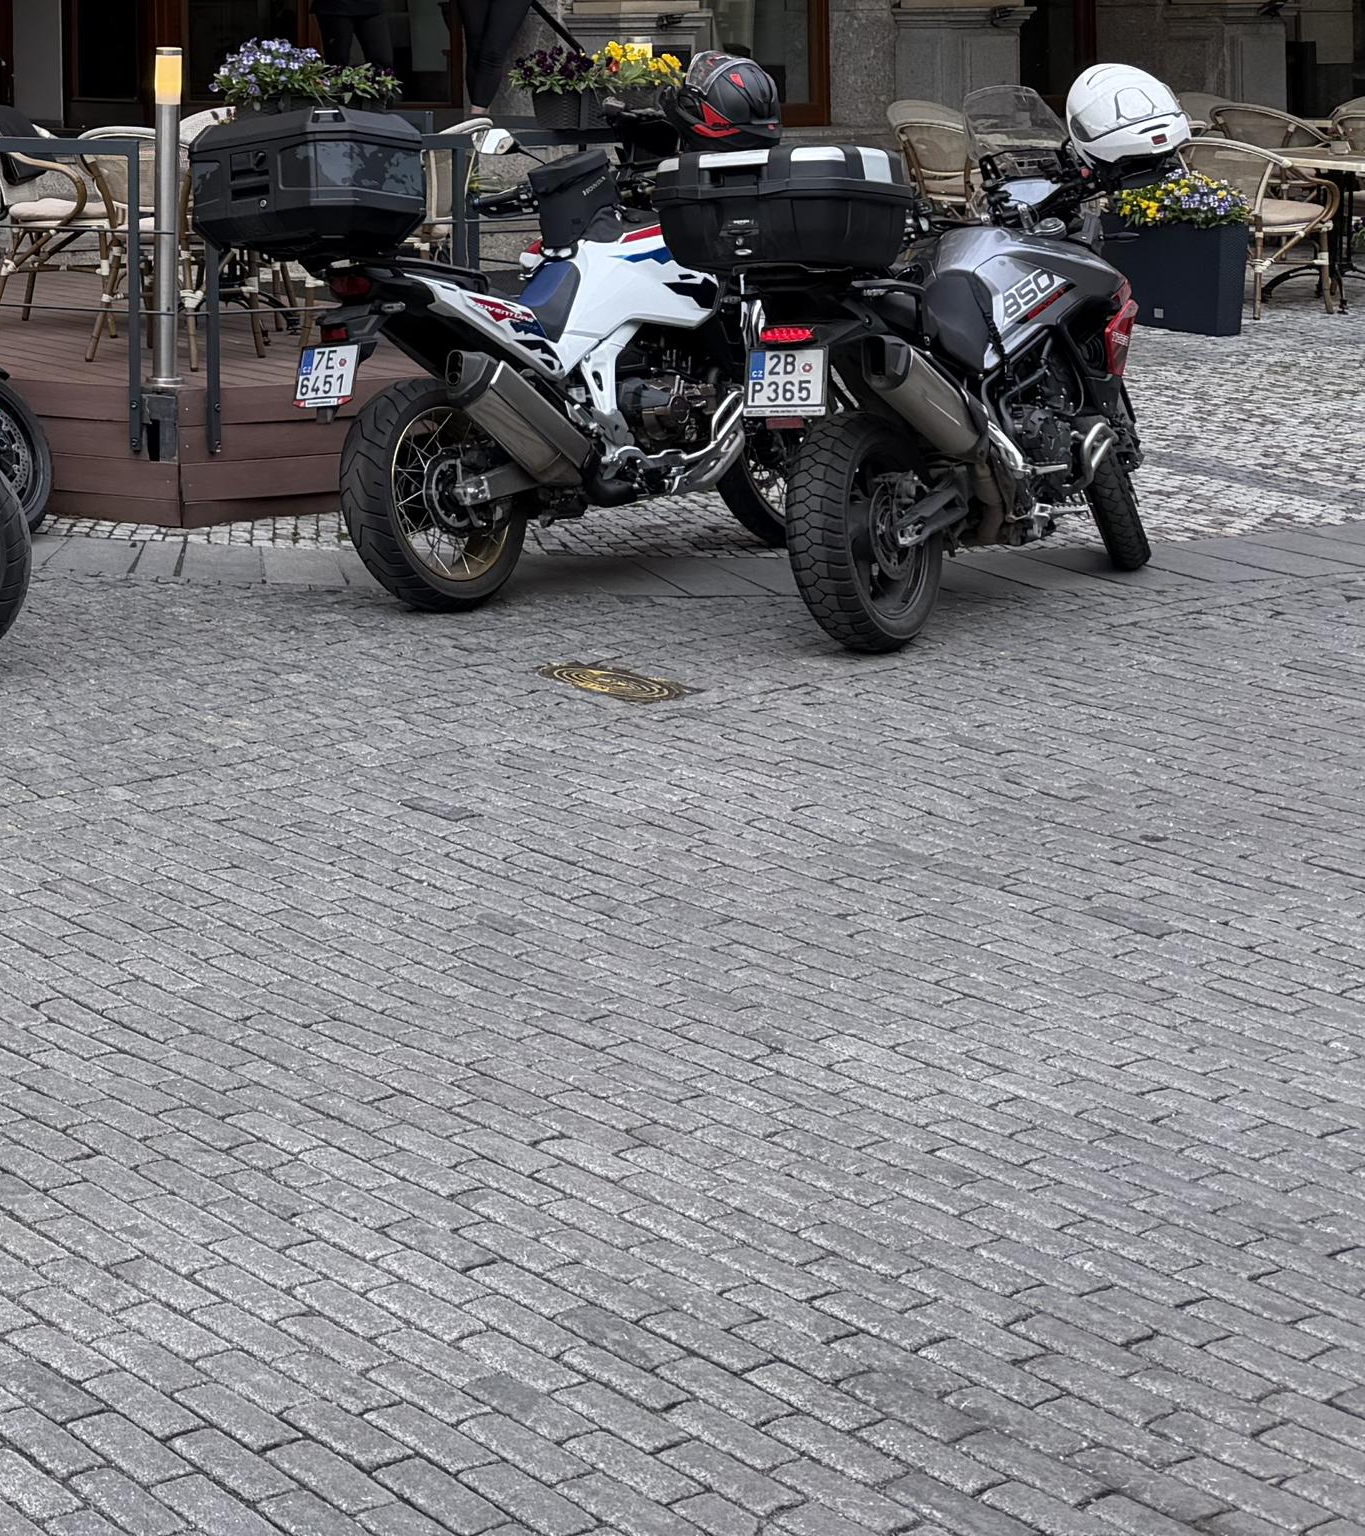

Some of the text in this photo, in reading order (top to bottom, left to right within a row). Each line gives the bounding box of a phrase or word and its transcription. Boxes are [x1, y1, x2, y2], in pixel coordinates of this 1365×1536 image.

[314, 349, 337, 371] 7E
[768, 353, 797, 376] 2B
[299, 373, 345, 396] 6451
[752, 370, 763, 378] CZ
[751, 379, 812, 403] P365
